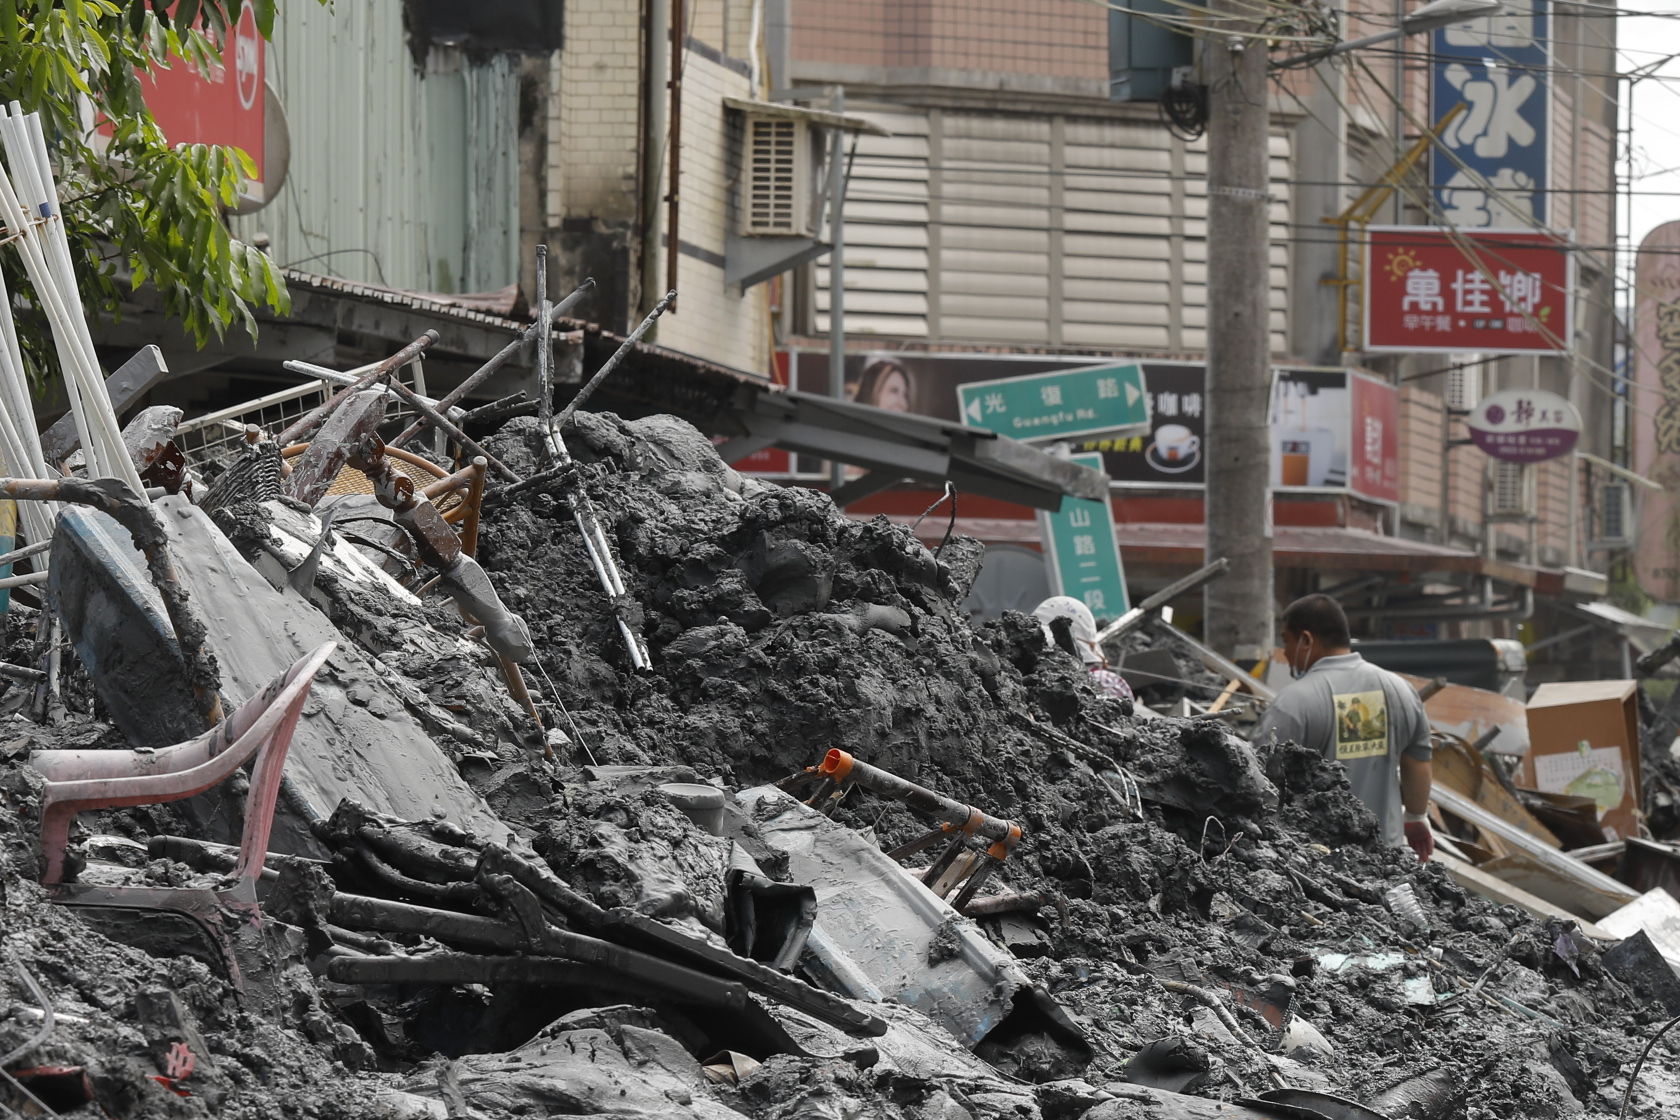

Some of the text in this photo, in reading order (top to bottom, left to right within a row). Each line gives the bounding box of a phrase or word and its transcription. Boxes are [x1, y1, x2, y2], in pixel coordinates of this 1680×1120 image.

[1402, 268, 1541, 314] 萬佳鄉
[984, 378, 1119, 414] 光復路
[1149, 391, 1202, 418] 咖啡
[1013, 411, 1074, 430] Guangfu
